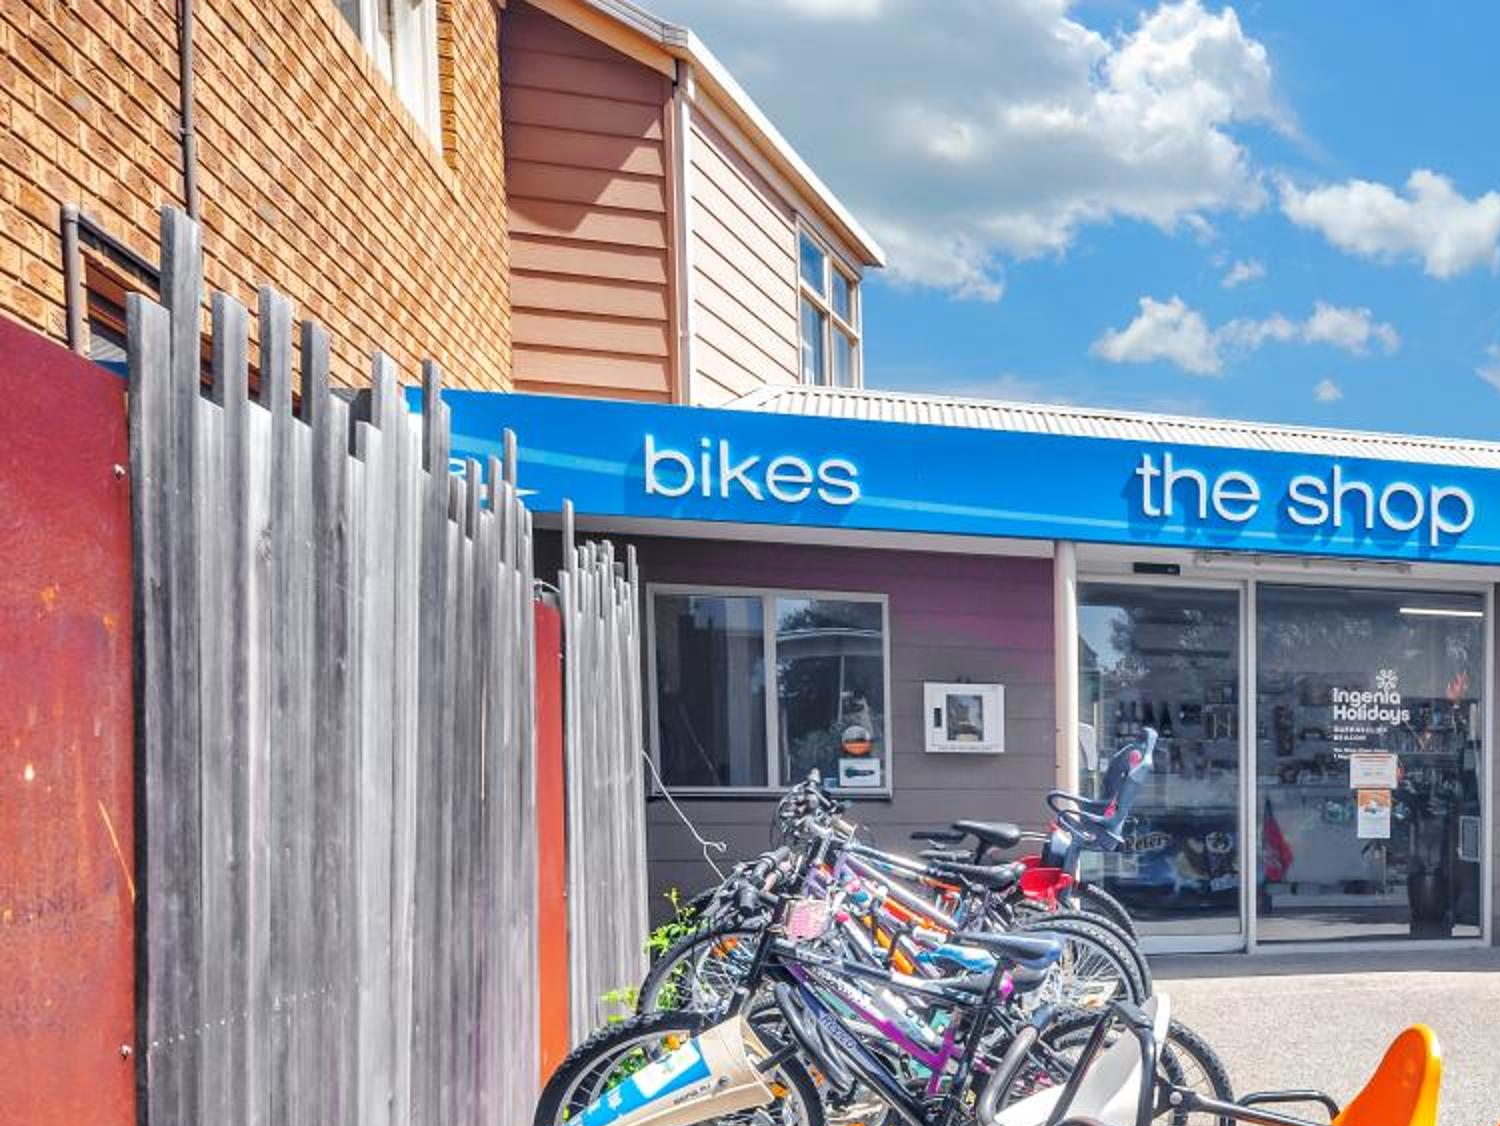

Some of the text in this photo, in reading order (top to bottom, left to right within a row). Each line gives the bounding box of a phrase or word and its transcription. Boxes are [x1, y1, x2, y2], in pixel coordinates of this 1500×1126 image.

[643, 434, 861, 506] bikes
[1135, 452, 1475, 546] the shop
[1333, 704, 1411, 726] Holidays
